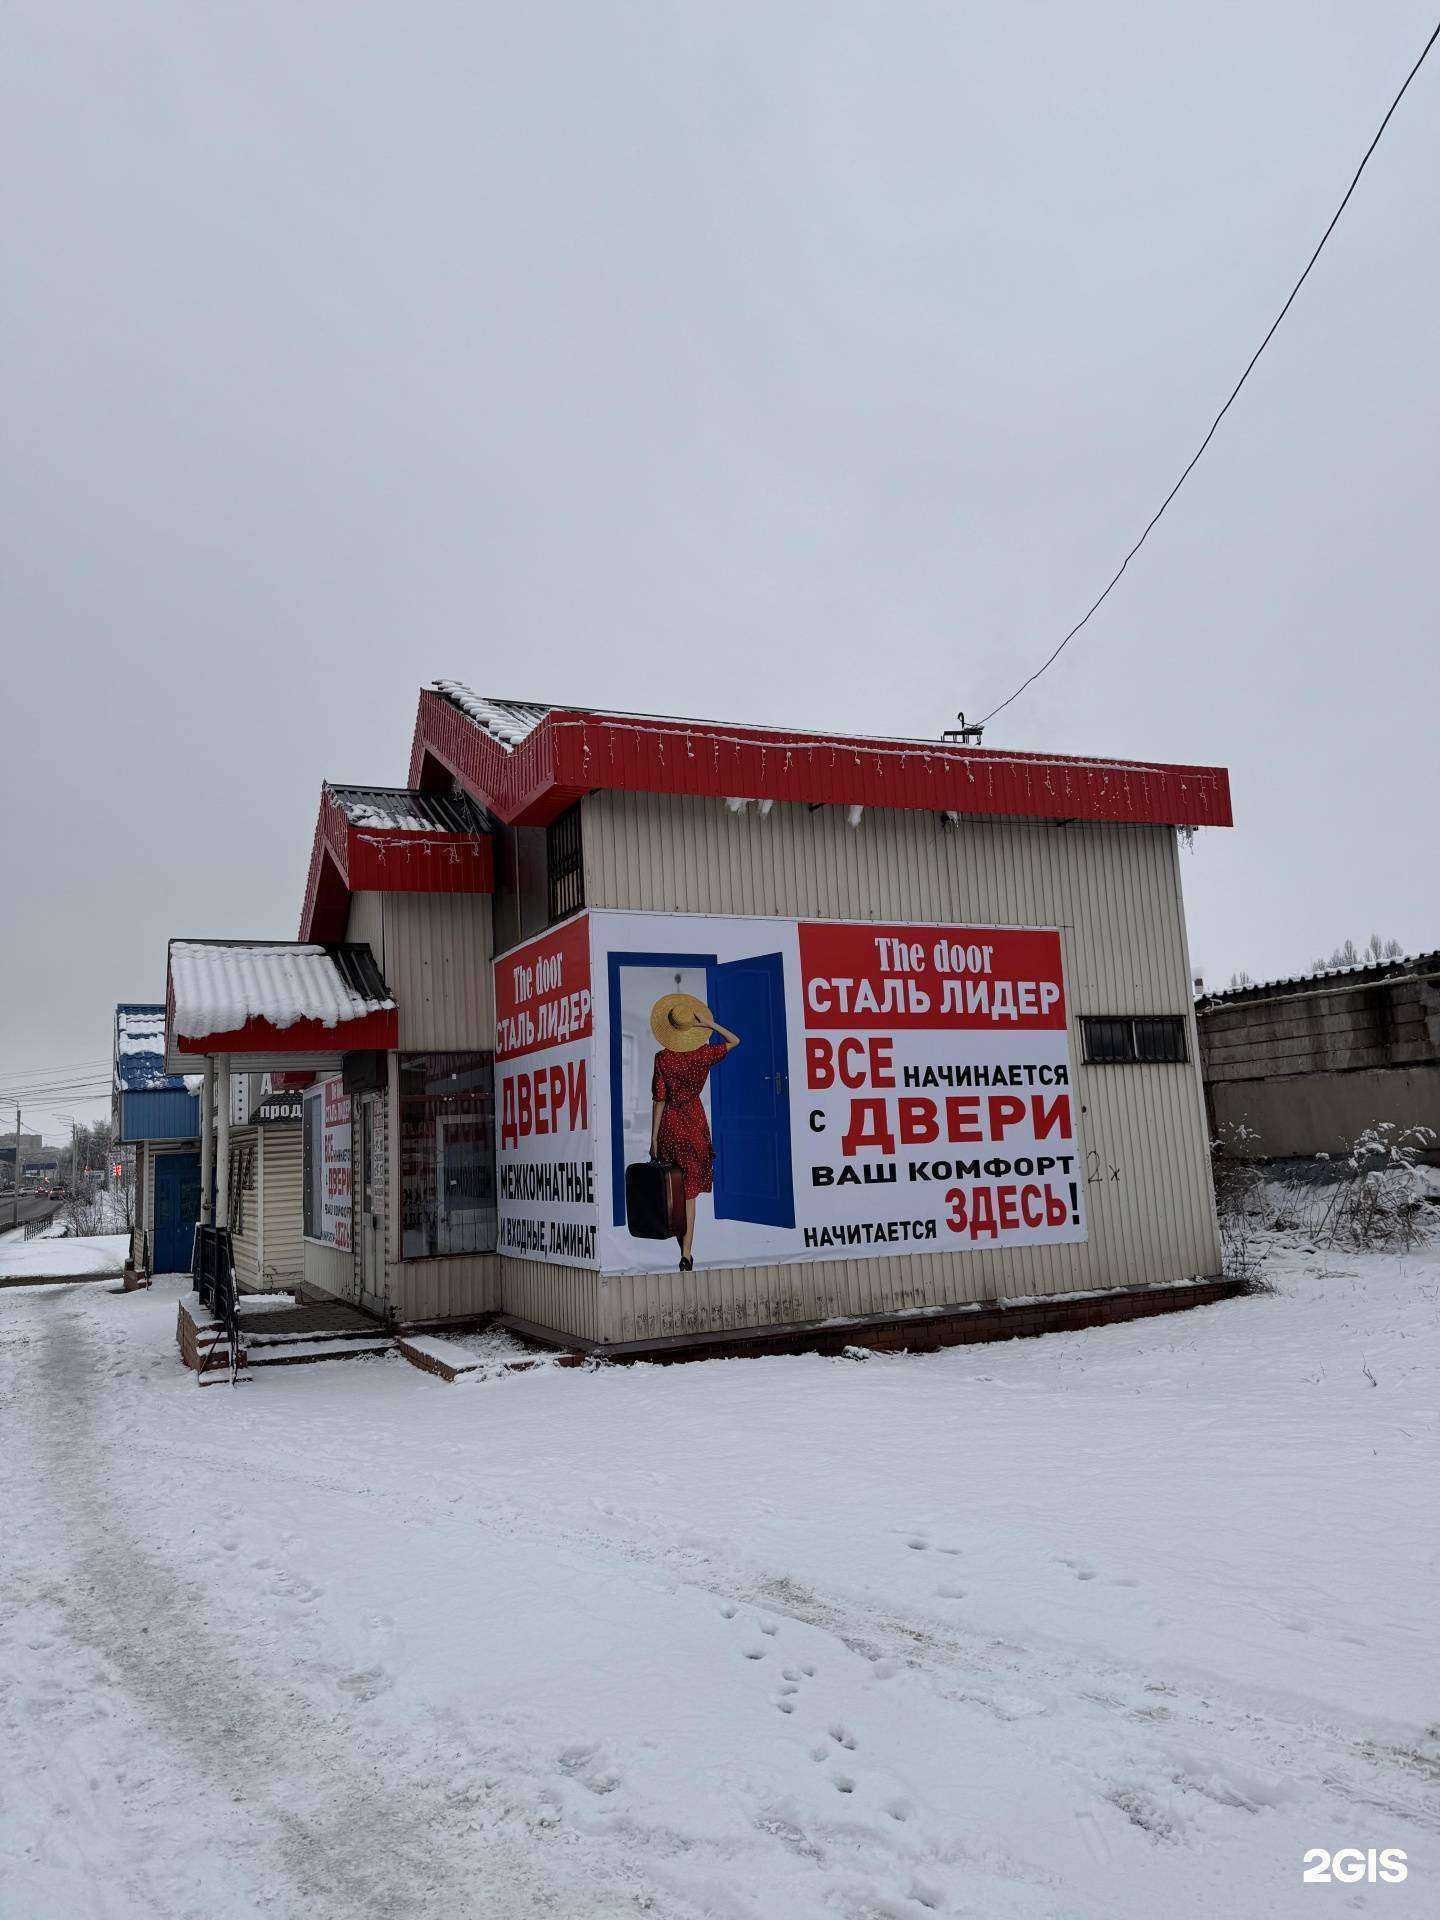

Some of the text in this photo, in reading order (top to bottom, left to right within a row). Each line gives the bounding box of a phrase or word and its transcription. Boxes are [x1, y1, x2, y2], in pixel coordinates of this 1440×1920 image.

[513, 952, 563, 1004] The door
[875, 937, 993, 974] The door
[495, 989, 591, 1054] СТАЛЬ ЛИДЕР
[808, 977, 1060, 1020] СТАЛЬ ЛИДЕР
[805, 1037, 1069, 1089] ВСЕ НАЧИНАЕТСЯ
[501, 1059, 588, 1151] ДВЕРИ
[841, 1094, 1073, 1156] ДВЕРИ
[500, 1162, 594, 1203] МЕЖКОМНАТНЫЕ
[811, 1155, 1075, 1187] ВАШ КОМФОРТ
[803, 1219, 937, 1248] НАЧИТАЕТСЯ
[944, 1182, 1080, 1240] ЗДЕСЬ!
[507, 1218, 548, 1258] ВХОДНЫЕ,
[549, 1221, 597, 1259] ЛАМИНАТ
